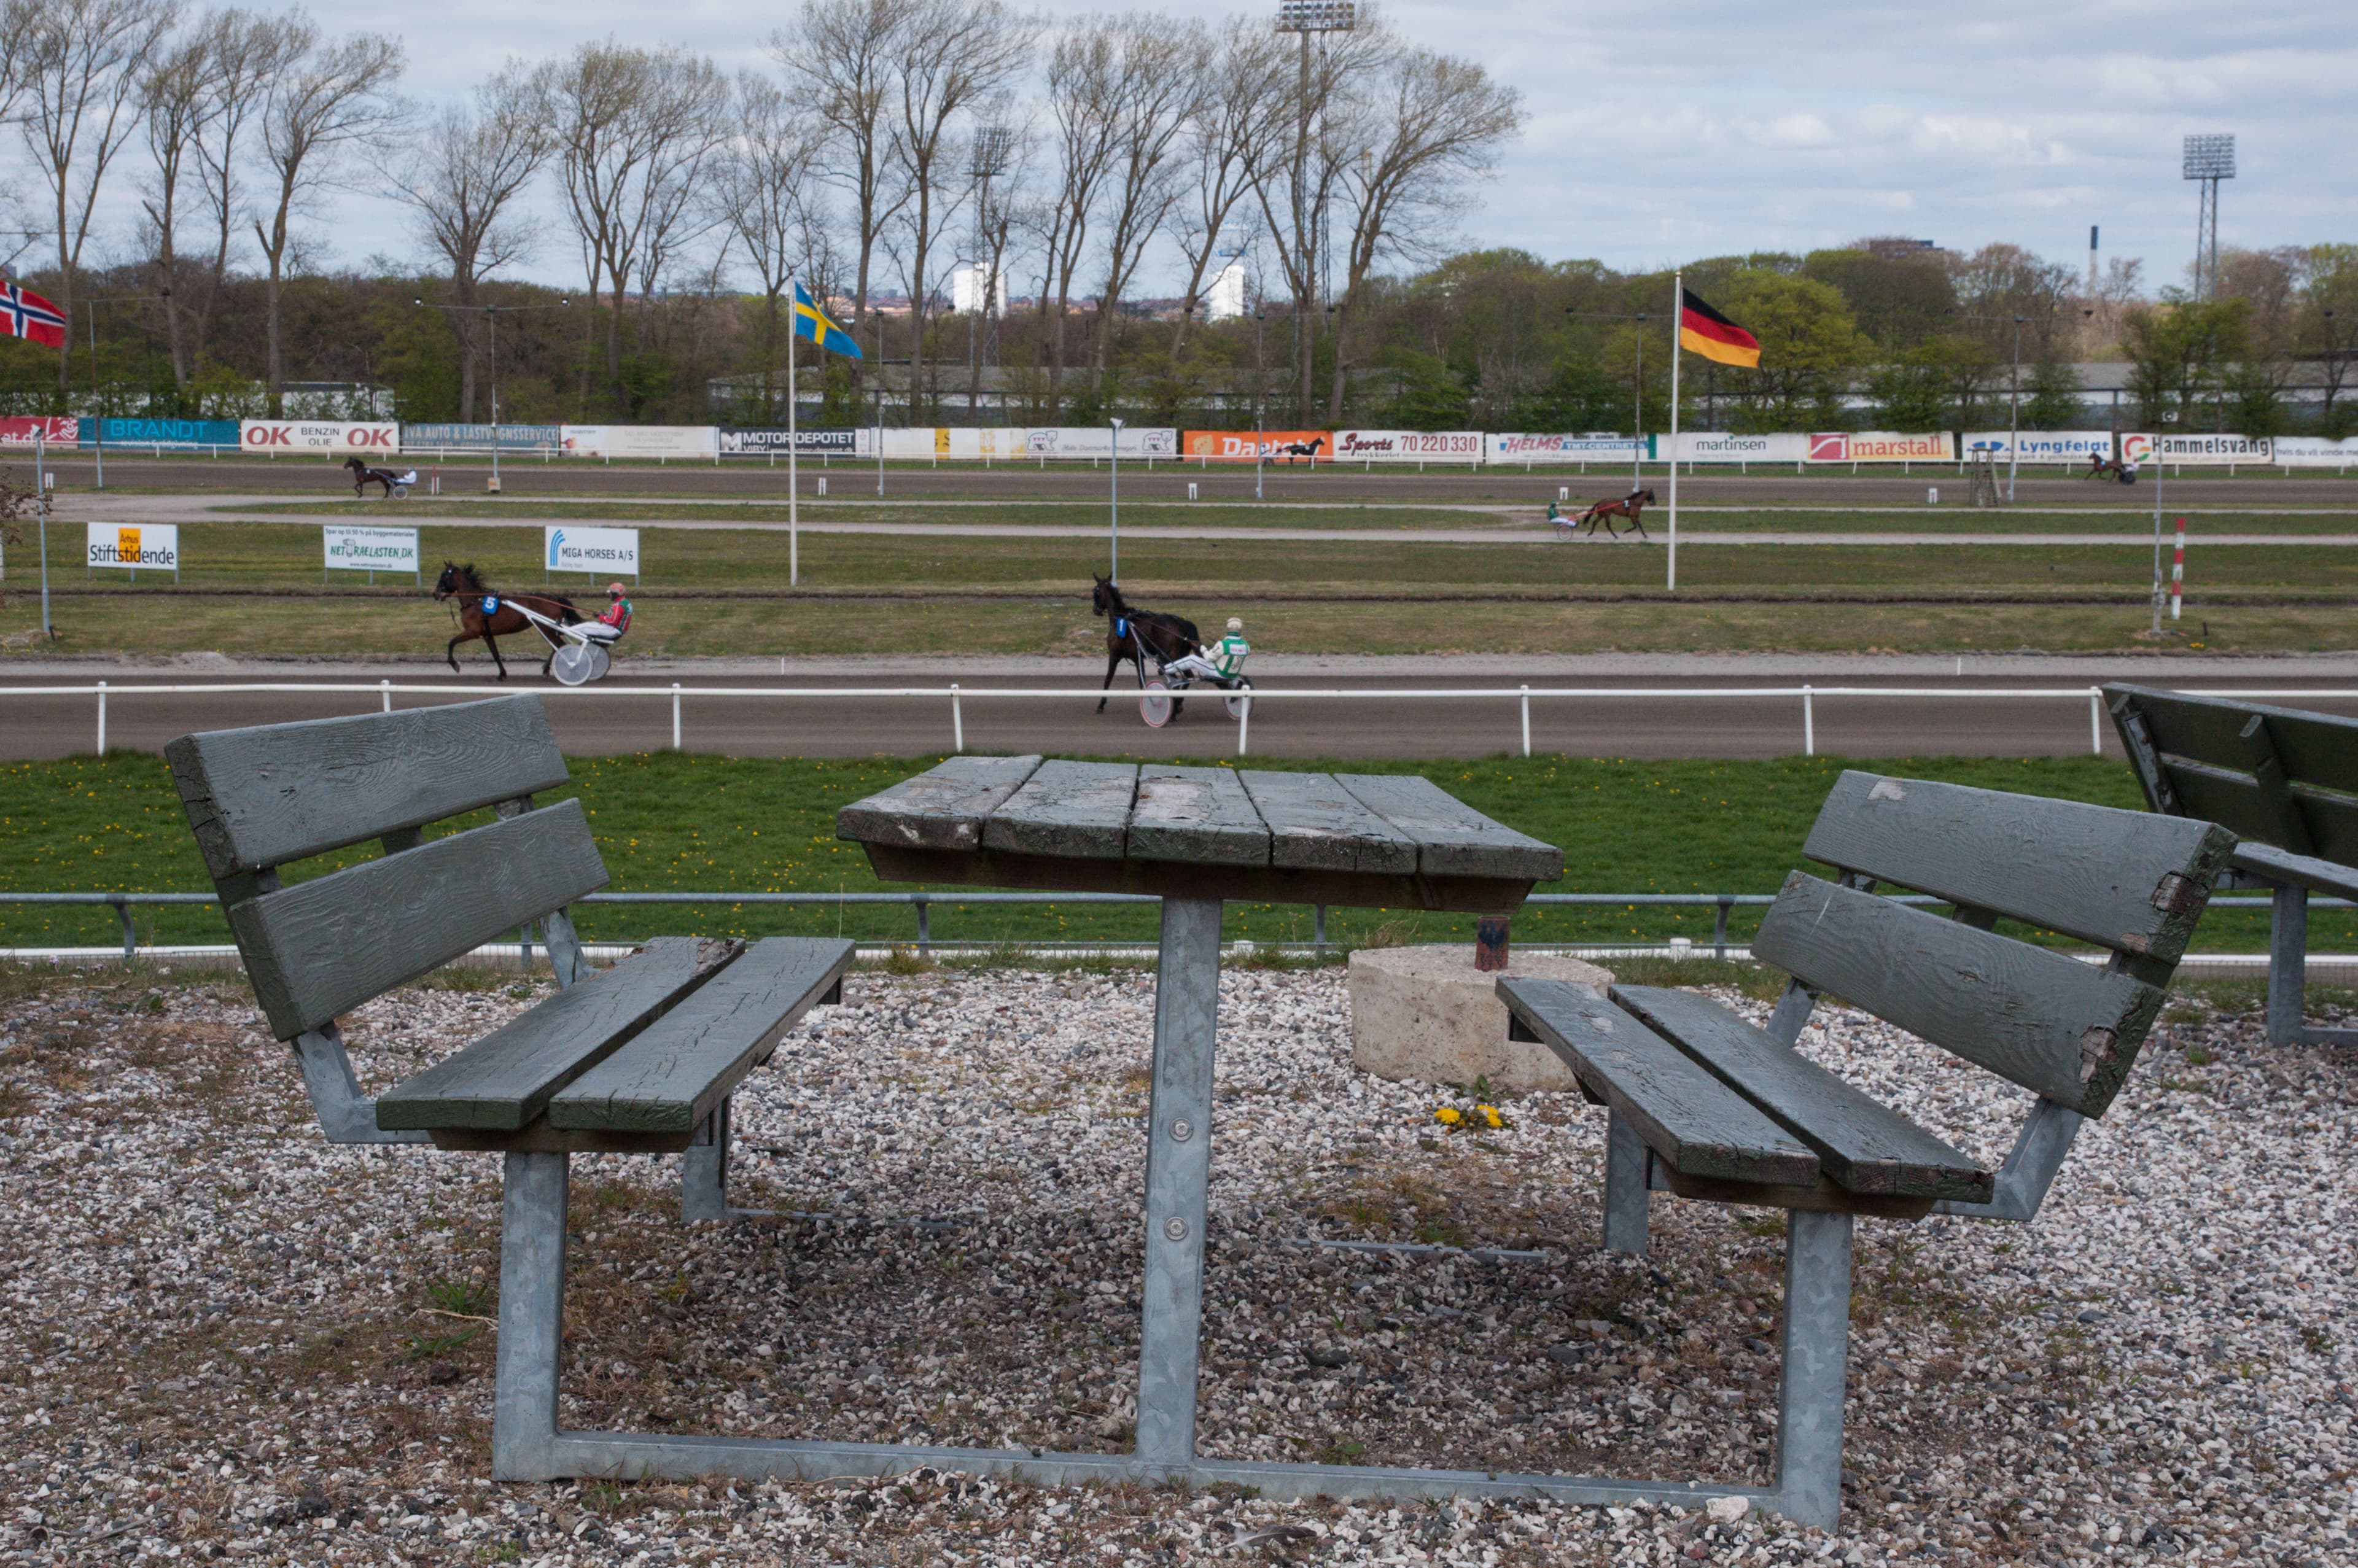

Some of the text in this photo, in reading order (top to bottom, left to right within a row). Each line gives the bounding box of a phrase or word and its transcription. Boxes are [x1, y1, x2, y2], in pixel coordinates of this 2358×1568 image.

[110, 420, 208, 438] BRANDT
[246, 426, 293, 445] OK
[301, 427, 340, 436] BENZIN
[347, 428, 394, 446] OK
[425, 425, 451, 439] AUTO
[454, 427, 460, 439] &
[309, 437, 332, 446] OLIE
[743, 432, 791, 443] MOTOR
[795, 432, 854, 443] DEPOTET
[1339, 432, 1393, 456] Sports
[1401, 435, 1477, 452] 70 220 330
[1506, 437, 1563, 453] HELMS
[1696, 435, 1766, 451] martinsen
[1853, 435, 1942, 456] marstall
[2152, 437, 2269, 456] Hammelsvang
[373, 529, 415, 538] byggematerialer
[90, 543, 174, 564] Stiftstidende
[561, 548, 634, 562] MIGA HORSES A/S
[485, 597, 495, 608] 5
[1119, 618, 1124, 632] 1
